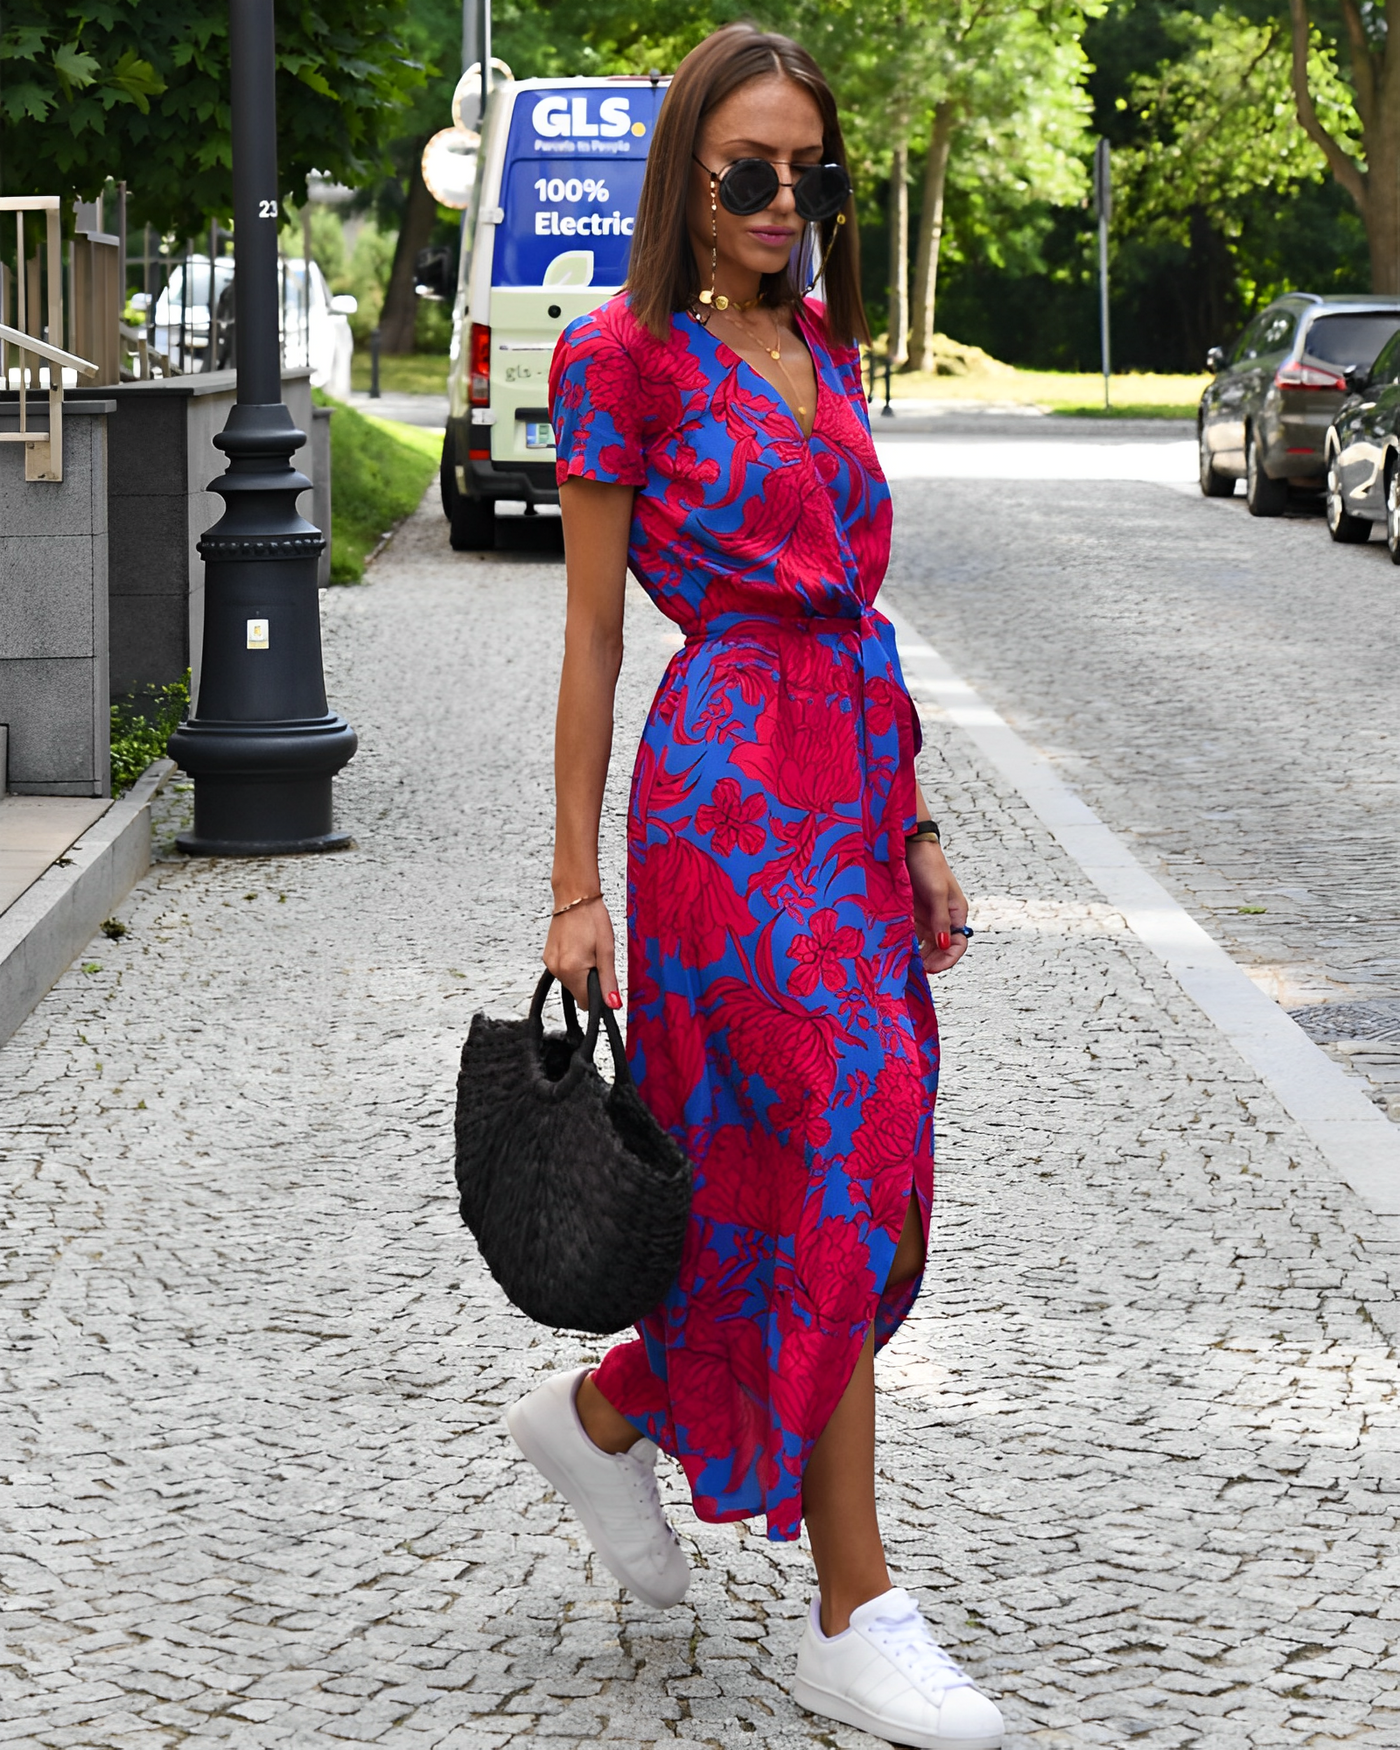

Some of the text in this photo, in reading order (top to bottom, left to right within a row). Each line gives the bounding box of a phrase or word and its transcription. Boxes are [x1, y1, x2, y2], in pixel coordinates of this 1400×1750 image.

[534, 178, 610, 203] 100%
[259, 200, 278, 218] 23
[534, 211, 635, 237] Electric
